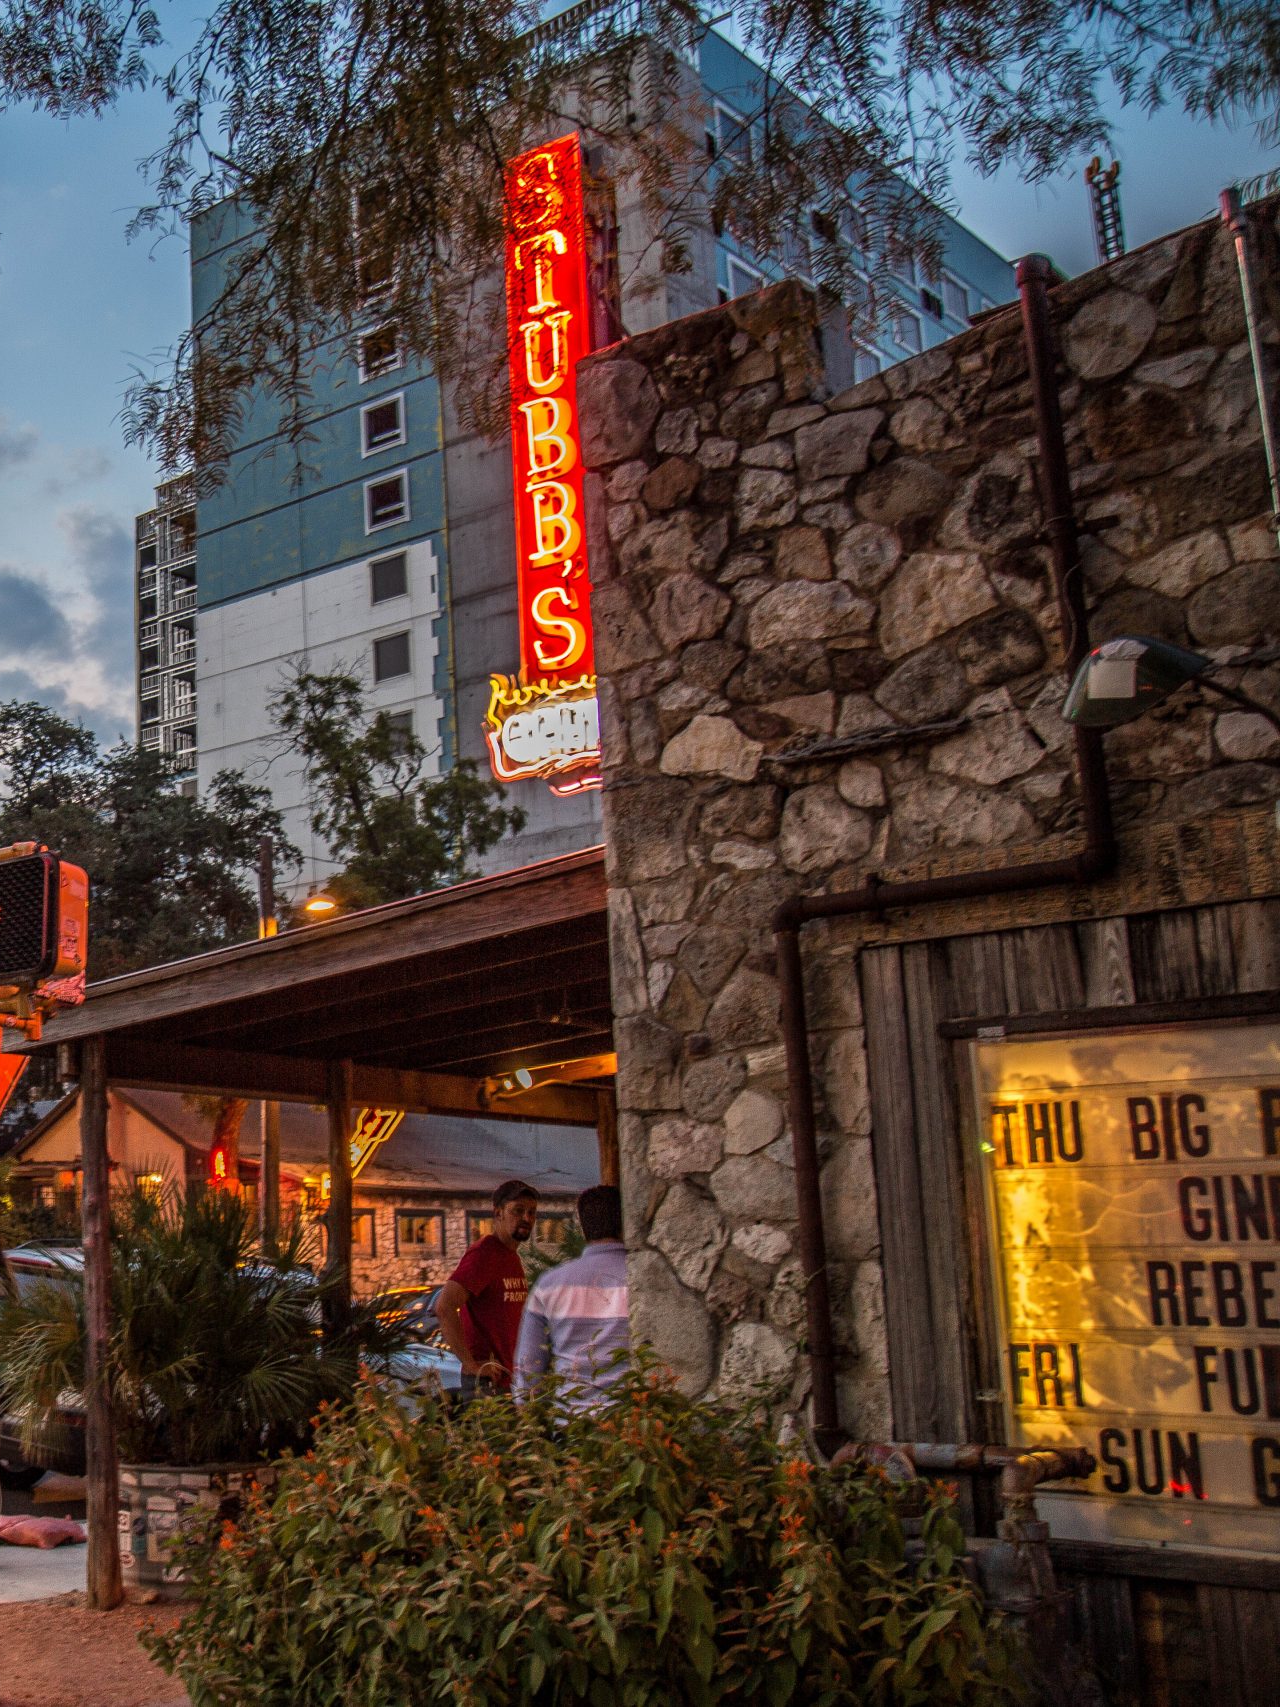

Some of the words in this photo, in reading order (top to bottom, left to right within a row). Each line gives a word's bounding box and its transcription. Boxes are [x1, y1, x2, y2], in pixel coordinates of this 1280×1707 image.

[514, 152, 588, 673] STUBB'S
[991, 1101, 1084, 1165] THU
[1127, 1092, 1210, 1161] BIG
[1010, 1343, 1085, 1407] FRI
[1100, 1427, 1204, 1500] SUN
